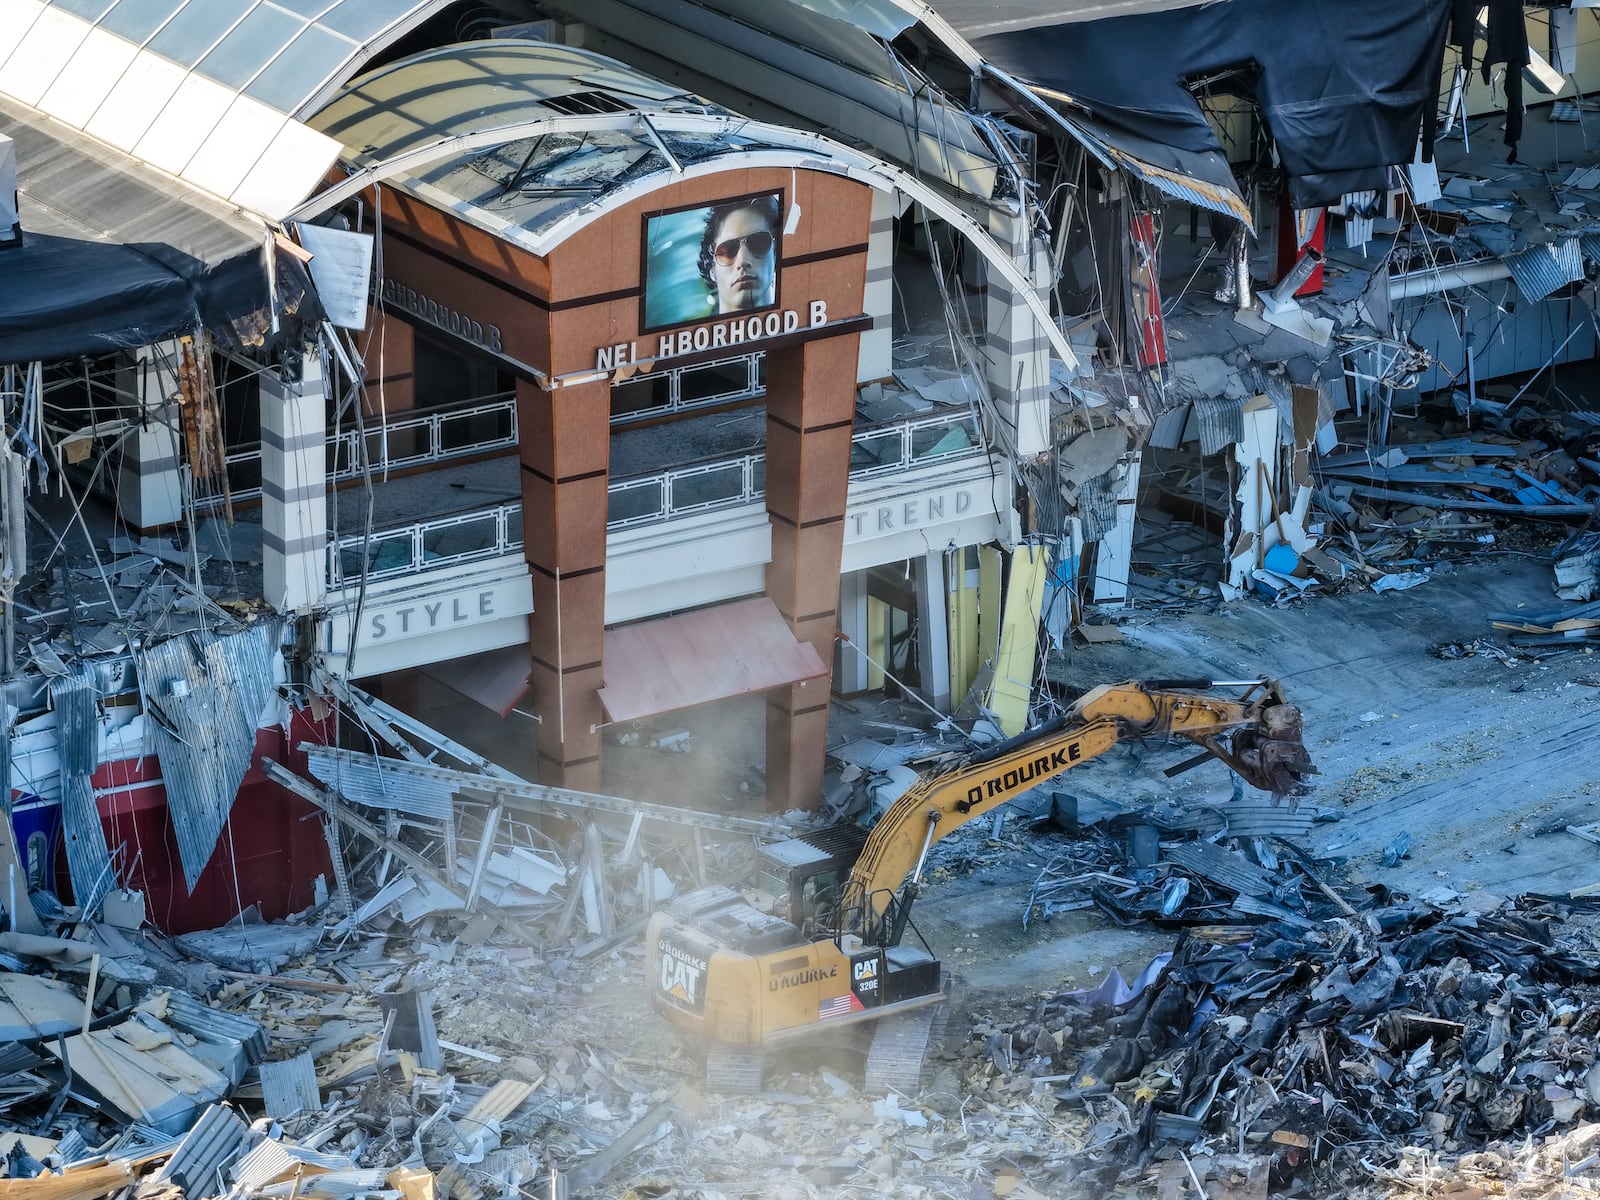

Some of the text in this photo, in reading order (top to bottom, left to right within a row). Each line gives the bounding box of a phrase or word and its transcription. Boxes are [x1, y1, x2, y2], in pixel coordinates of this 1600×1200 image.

[489, 324, 502, 354] B
[659, 310, 799, 358] HBORHOOD
[810, 300, 828, 328] B
[852, 490, 971, 536] TREND
[372, 591, 494, 639] STYLE
[967, 742, 1081, 807] O'ROURKE
[661, 953, 700, 1004] CAT
[854, 958, 879, 980] CAT
[859, 979, 879, 992] 320E
